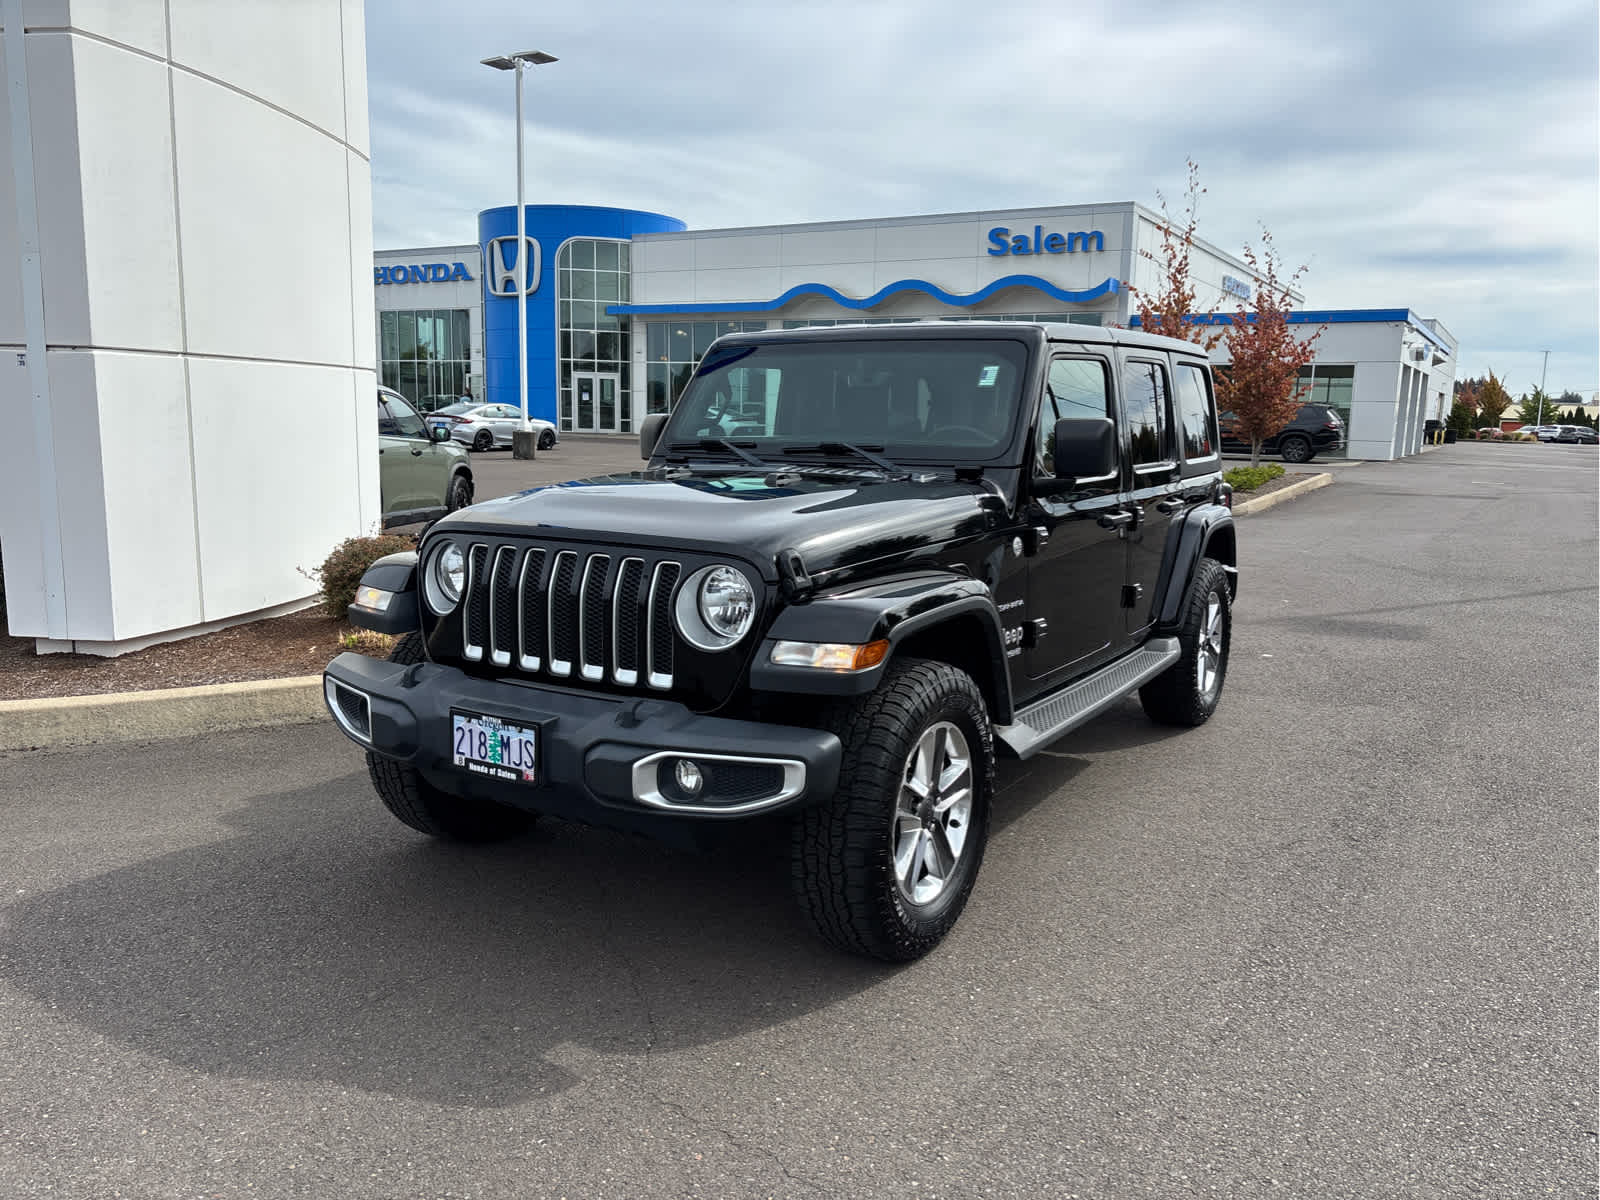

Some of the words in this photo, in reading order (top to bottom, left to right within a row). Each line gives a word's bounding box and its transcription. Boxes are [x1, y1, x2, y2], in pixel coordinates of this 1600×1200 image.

[987, 225, 1104, 256] Salem
[374, 262, 473, 285] HONDA
[456, 726, 488, 760] 218
[500, 734, 534, 769] MJS
